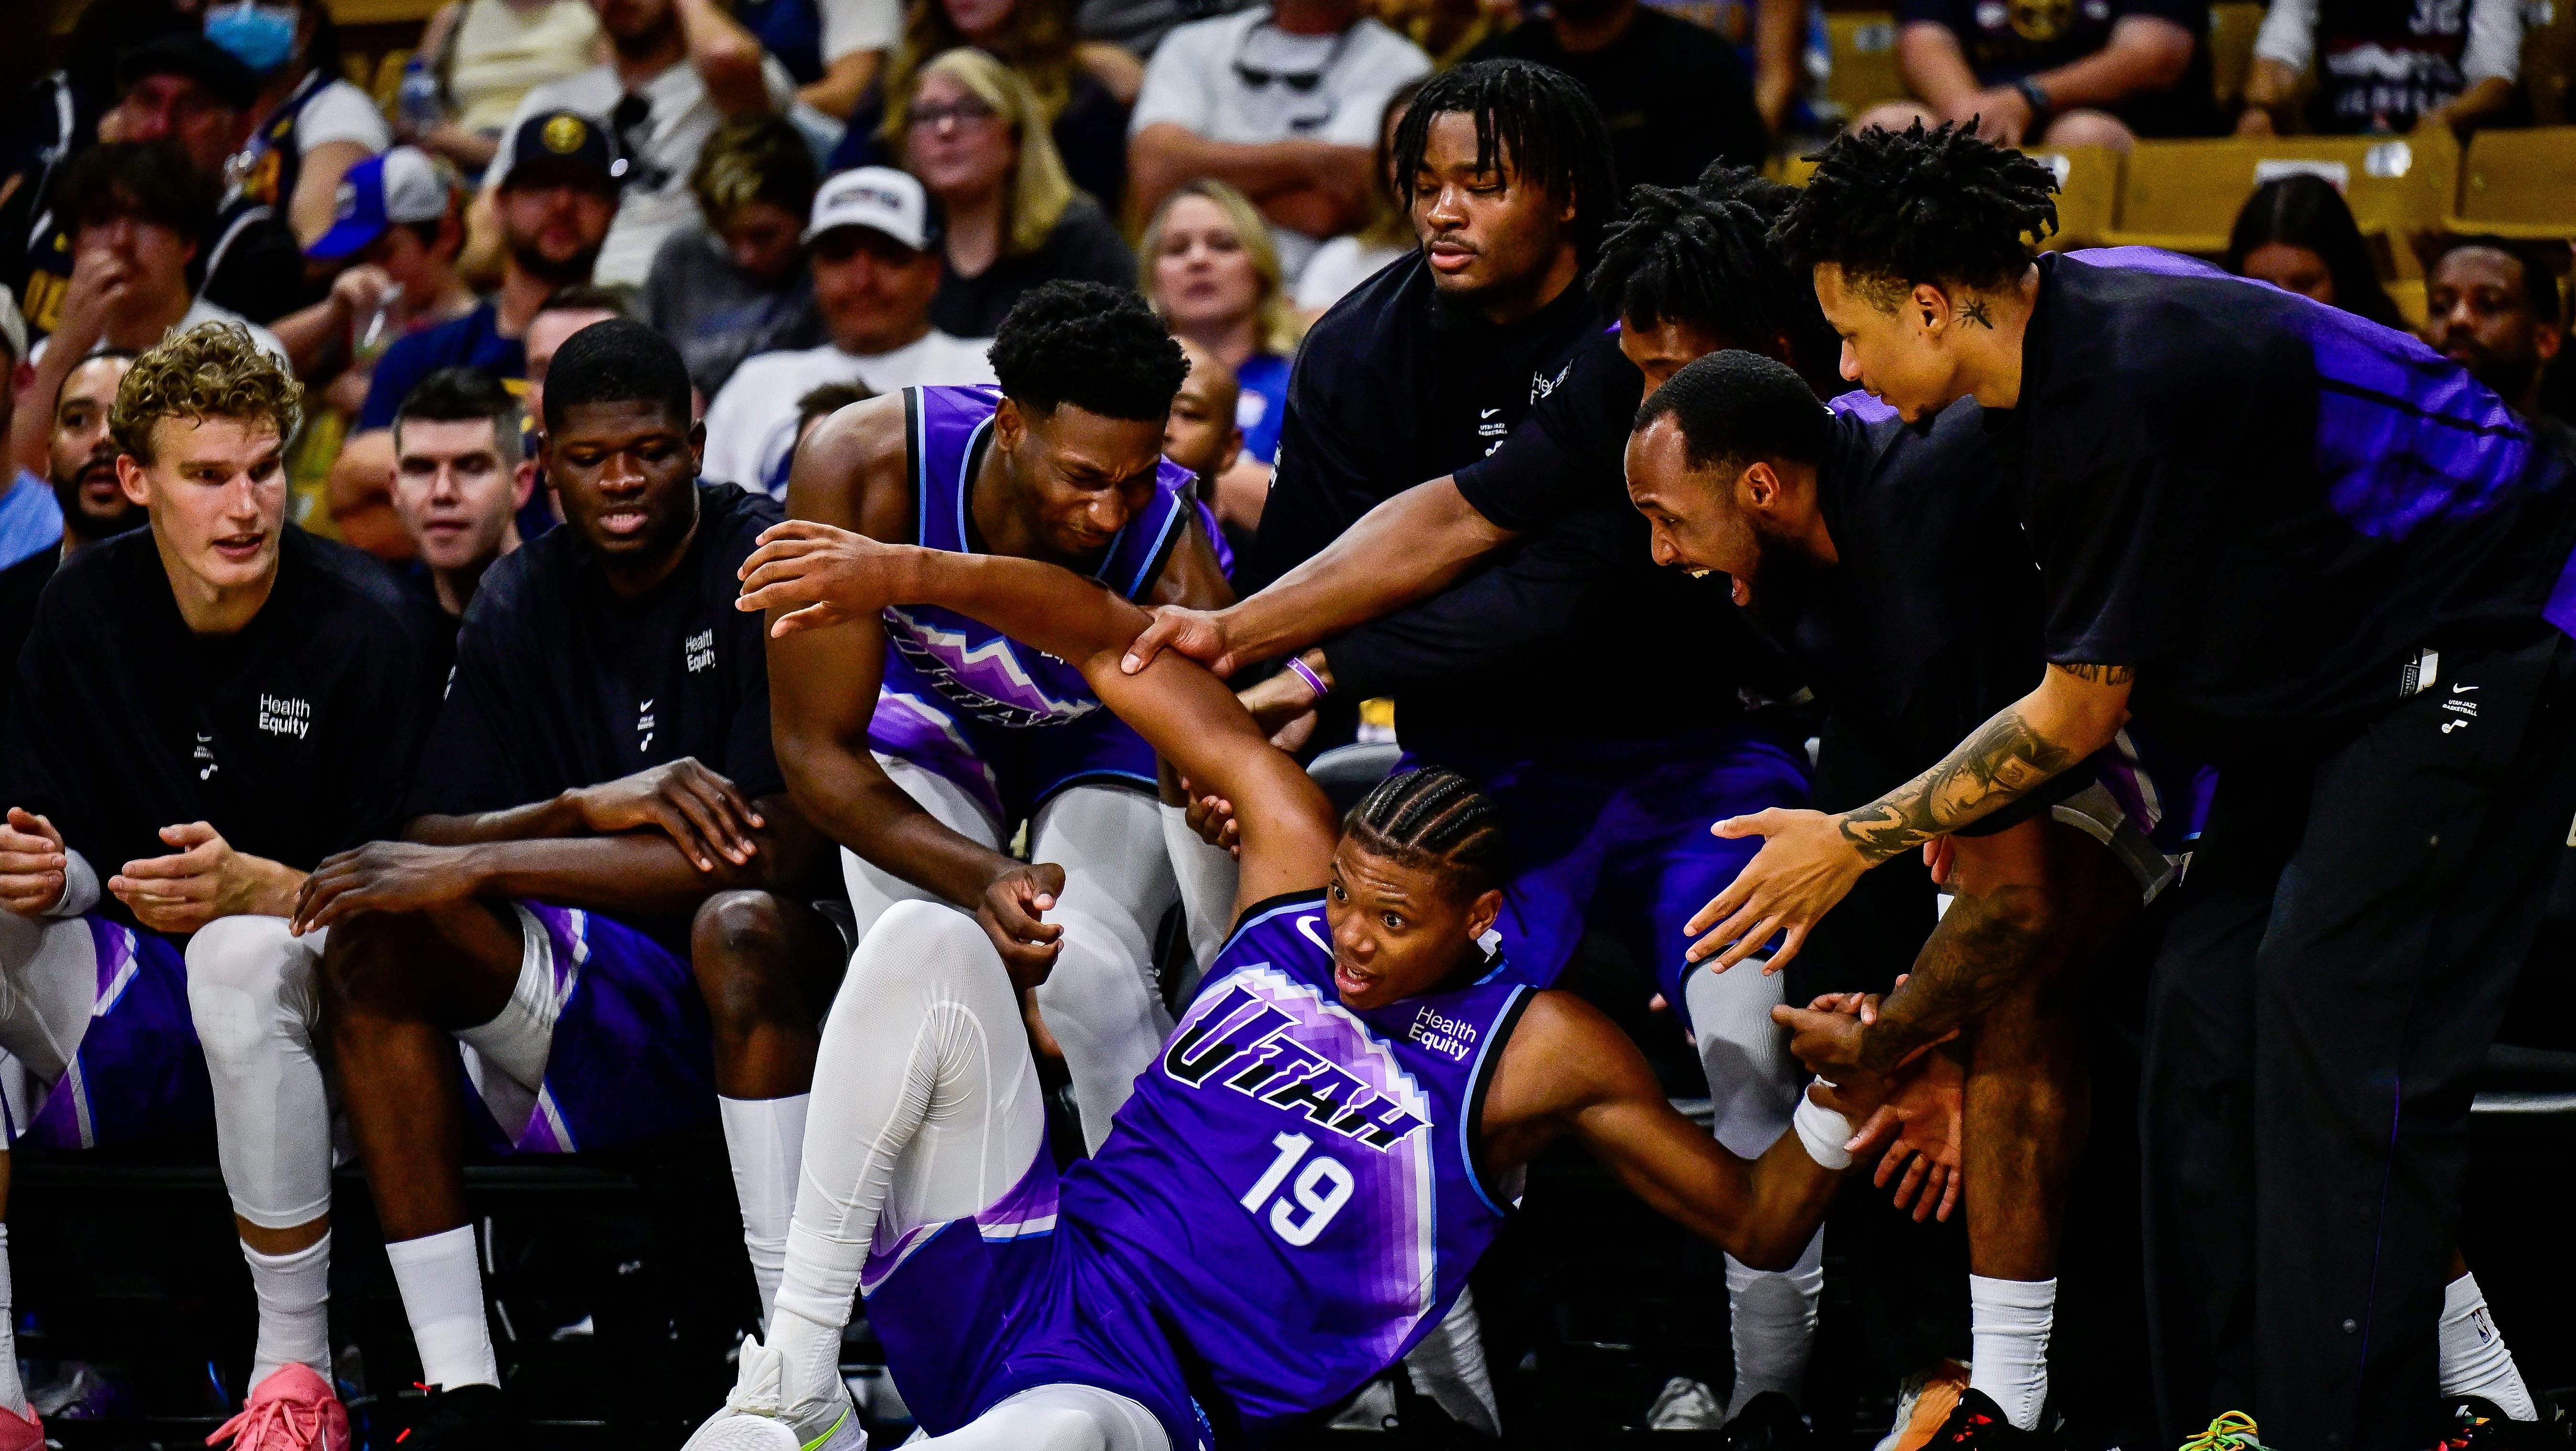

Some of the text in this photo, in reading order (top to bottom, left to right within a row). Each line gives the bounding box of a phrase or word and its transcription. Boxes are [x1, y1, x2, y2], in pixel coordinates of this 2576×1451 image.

[260, 692, 311, 719] Health
[2442, 703, 2478, 717] BASKETBALL
[2462, 701, 2478, 709] JAZZ
[259, 712, 309, 740] Equity
[1416, 1006, 1477, 1043] Health
[1408, 1022, 1471, 1062] Equity
[1164, 985, 1434, 1153] UTAH
[1240, 1130, 1354, 1246] 19
